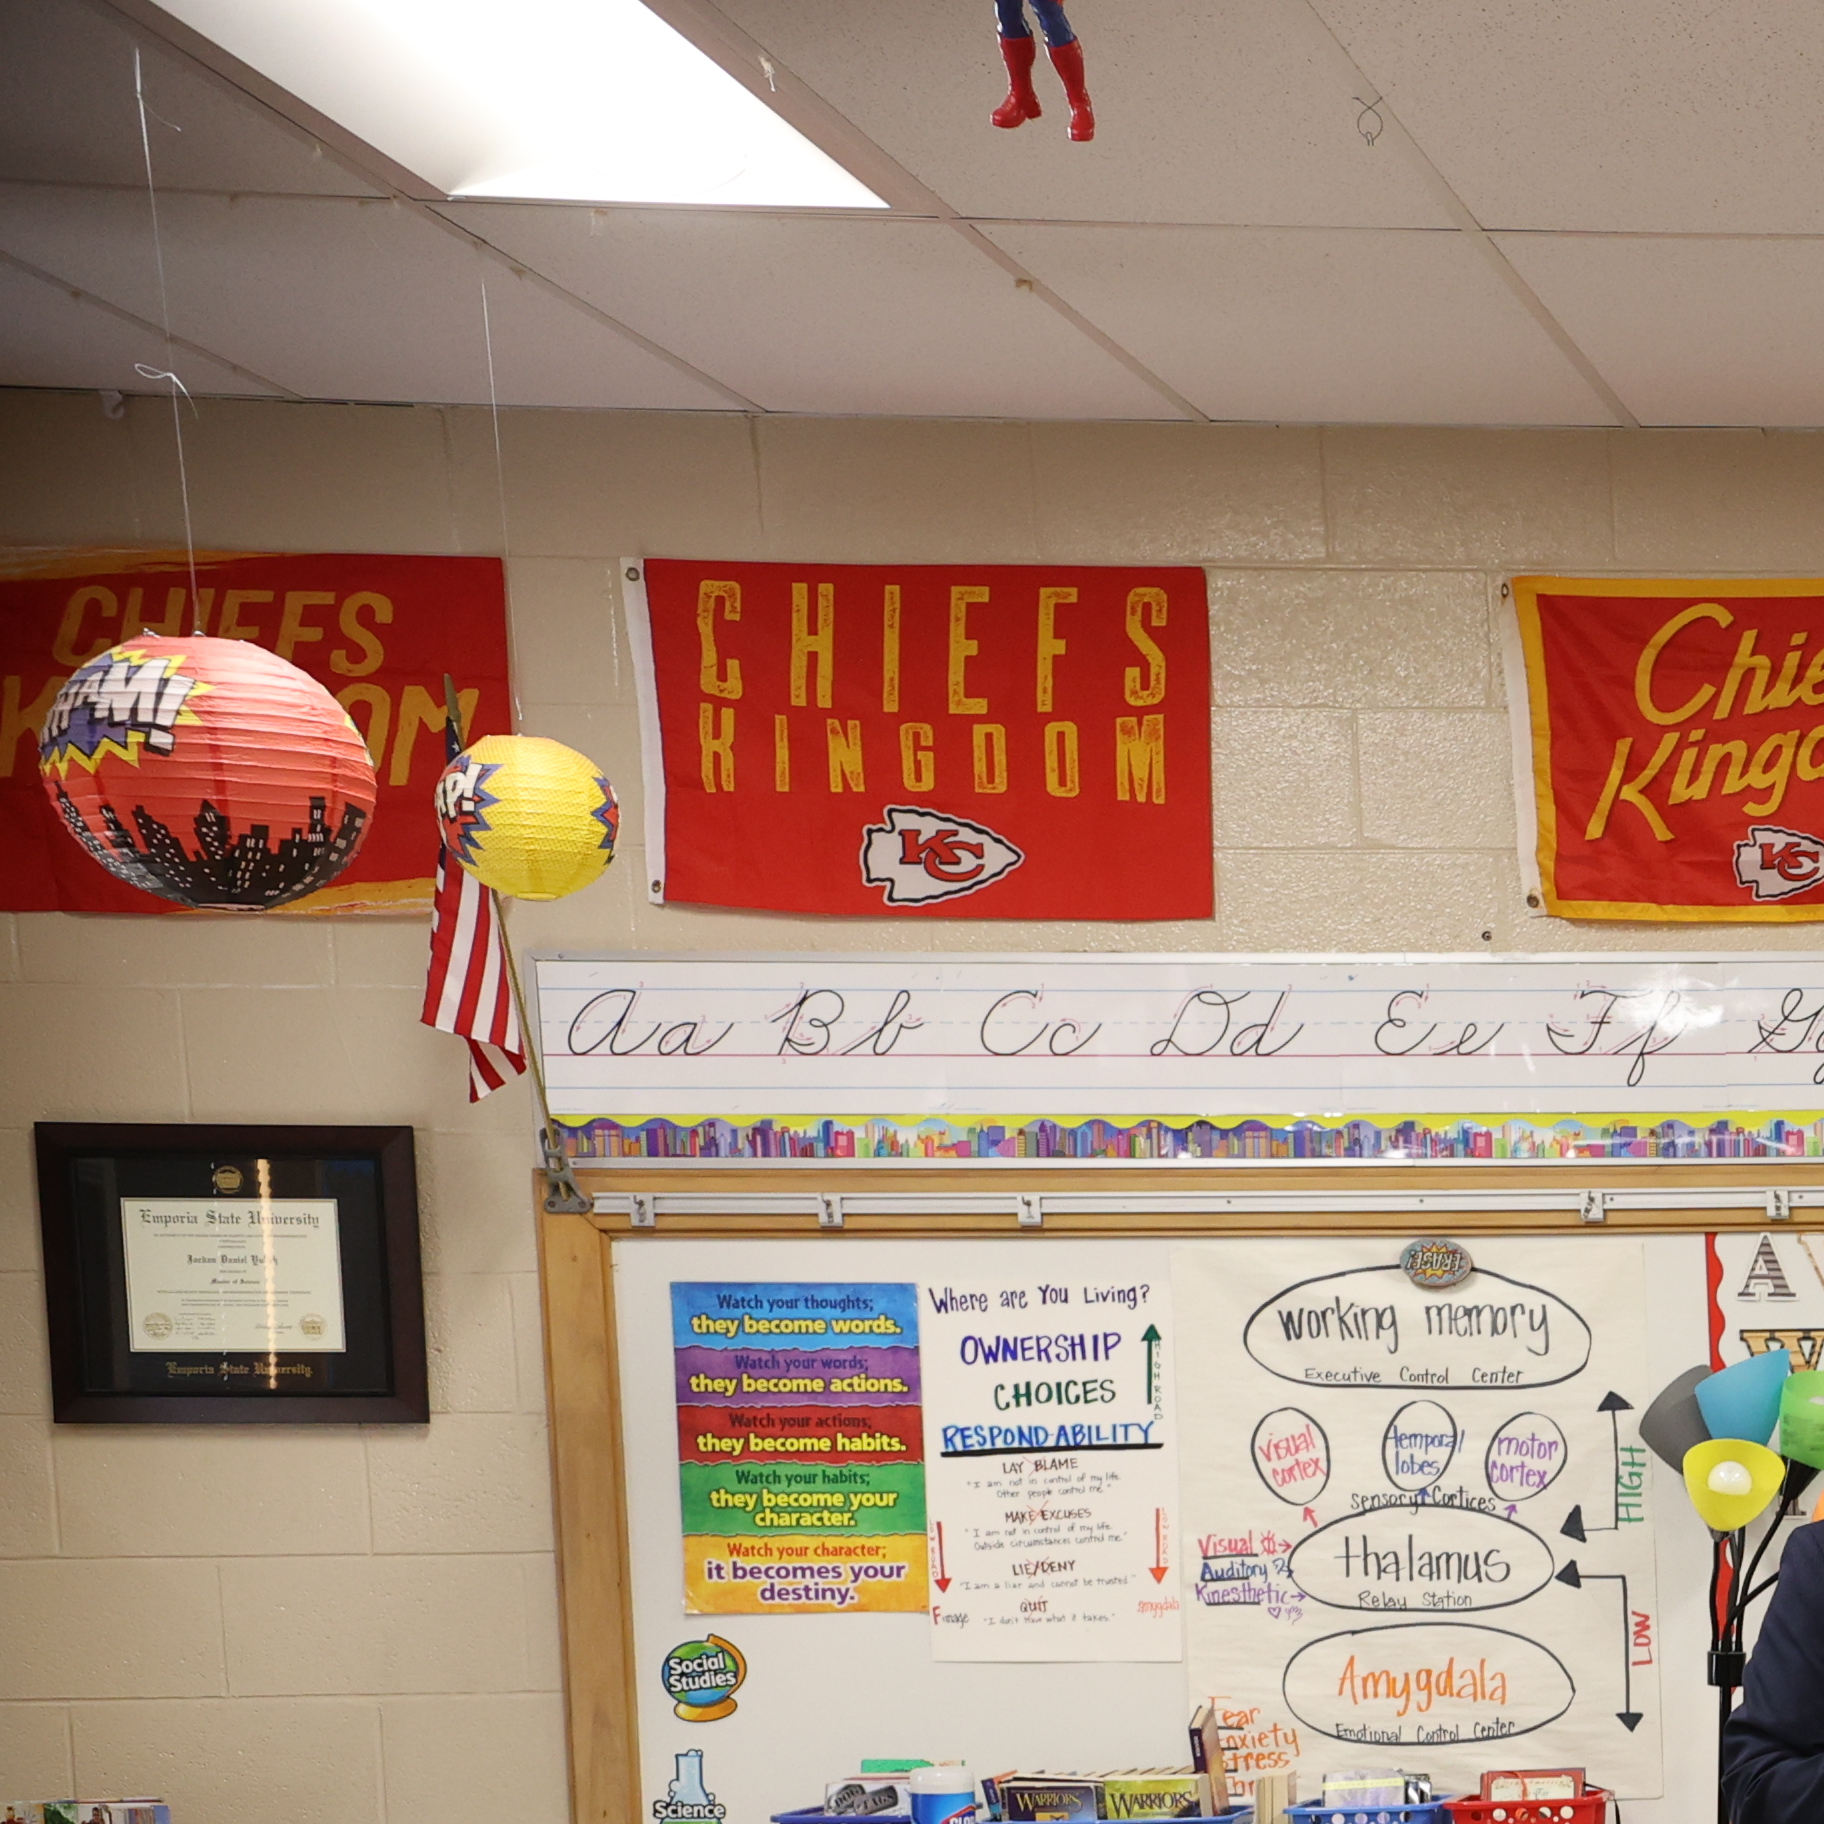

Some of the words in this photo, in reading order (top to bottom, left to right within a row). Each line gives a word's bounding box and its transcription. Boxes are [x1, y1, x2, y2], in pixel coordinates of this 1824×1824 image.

[697, 579, 1168, 714] CHIEFS
[698, 701, 1166, 804] KINGDOM
[139, 1209, 198, 1227] Emporia
[205, 1209, 241, 1226] State
[1406, 1250, 1461, 1271] ERASE!
[717, 1294, 763, 1310] Watch
[767, 1297, 800, 1313] your
[804, 1294, 874, 1313] thoughts;
[929, 1287, 988, 1314] Where
[1000, 1289, 1027, 1310] are
[1038, 1284, 1068, 1305] You
[1083, 1284, 1150, 1311] Living?
[691, 1314, 739, 1337] they
[744, 1316, 826, 1333] become
[832, 1315, 902, 1333] words.
[1278, 1296, 1399, 1355] working
[1424, 1302, 1549, 1356] memory
[960, 1332, 1122, 1366] OWNERSHIP
[735, 1355, 780, 1369] Watch
[784, 1358, 818, 1373] your
[821, 1355, 868, 1371] words;
[689, 1374, 737, 1396] they
[742, 1375, 824, 1393] become
[830, 1375, 909, 1393] actions.
[1304, 1368, 1381, 1384] Executive
[1399, 1368, 1449, 1384] Control
[1472, 1369, 1524, 1385] Center
[994, 1379, 1116, 1410] CHOICES
[729, 1414, 775, 1428] Watch
[779, 1417, 812, 1432] your
[815, 1415, 872, 1429] actions;
[697, 1433, 744, 1455] they
[749, 1433, 831, 1452] become
[837, 1433, 906, 1452] habits.
[1258, 1425, 1316, 1463] visual
[1385, 1425, 1465, 1452] temporal
[1497, 1435, 1558, 1460] motor
[1002, 1461, 1024, 1474] LAY
[1033, 1457, 1079, 1472] BLAME
[1271, 1458, 1326, 1489] cortex
[1394, 1448, 1440, 1477] lobes
[735, 1471, 781, 1485] Watch
[785, 1473, 818, 1488] your
[822, 1470, 870, 1486] habits;
[1489, 1461, 1548, 1490] cortex
[1618, 1446, 1647, 1524] HIGH
[710, 1490, 757, 1511] they
[762, 1490, 845, 1507] become
[850, 1492, 897, 1511] your
[755, 1509, 855, 1526] character.
[1005, 1510, 1035, 1523] MAKE
[1041, 1509, 1091, 1520] EXCUSES
[727, 1543, 773, 1558] Watch
[777, 1547, 810, 1560] your
[814, 1543, 887, 1559] character;
[1198, 1531, 1258, 1558] Visual
[1334, 1534, 1510, 1584] thalamus
[706, 1560, 724, 1581] it
[732, 1560, 842, 1581] becomes
[850, 1563, 905, 1584] your
[1200, 1562, 1268, 1587] Auditory
[760, 1582, 855, 1605] destiny.
[1194, 1584, 1292, 1606] Kinesthetic
[1358, 1591, 1407, 1610] Relay
[1422, 1591, 1473, 1608] Station
[1632, 1611, 1651, 1666] LOW
[669, 1655, 725, 1675] Social
[669, 1671, 737, 1692] Studies
[1338, 1655, 1508, 1717] Amygdala
[1335, 1722, 1402, 1744] Emotional
[1416, 1721, 1462, 1742] Control
[1473, 1720, 1516, 1740] Center
[653, 1801, 726, 1820] Science
[1016, 1792, 1082, 1810] WARRIORS
[1108, 1789, 1199, 1817] WARRIORS
